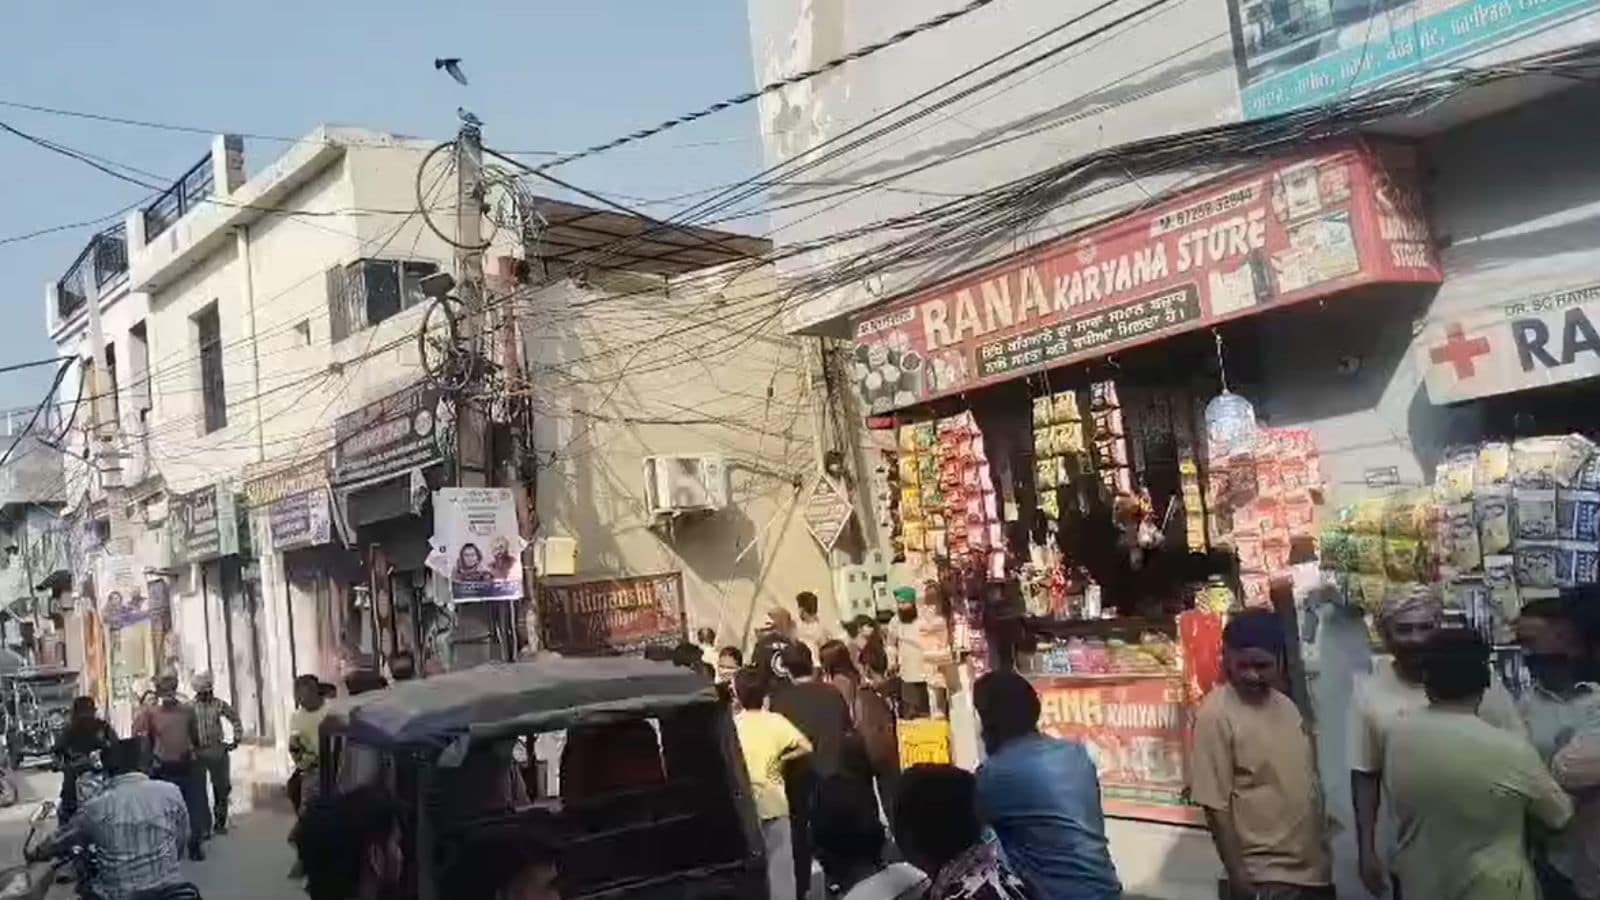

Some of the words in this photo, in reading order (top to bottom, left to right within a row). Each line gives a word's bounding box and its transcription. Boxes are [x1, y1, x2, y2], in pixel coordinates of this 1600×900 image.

[921, 267, 1051, 350] RANA
[1053, 243, 1168, 311] KARYANA
[1176, 208, 1266, 272] STORE
